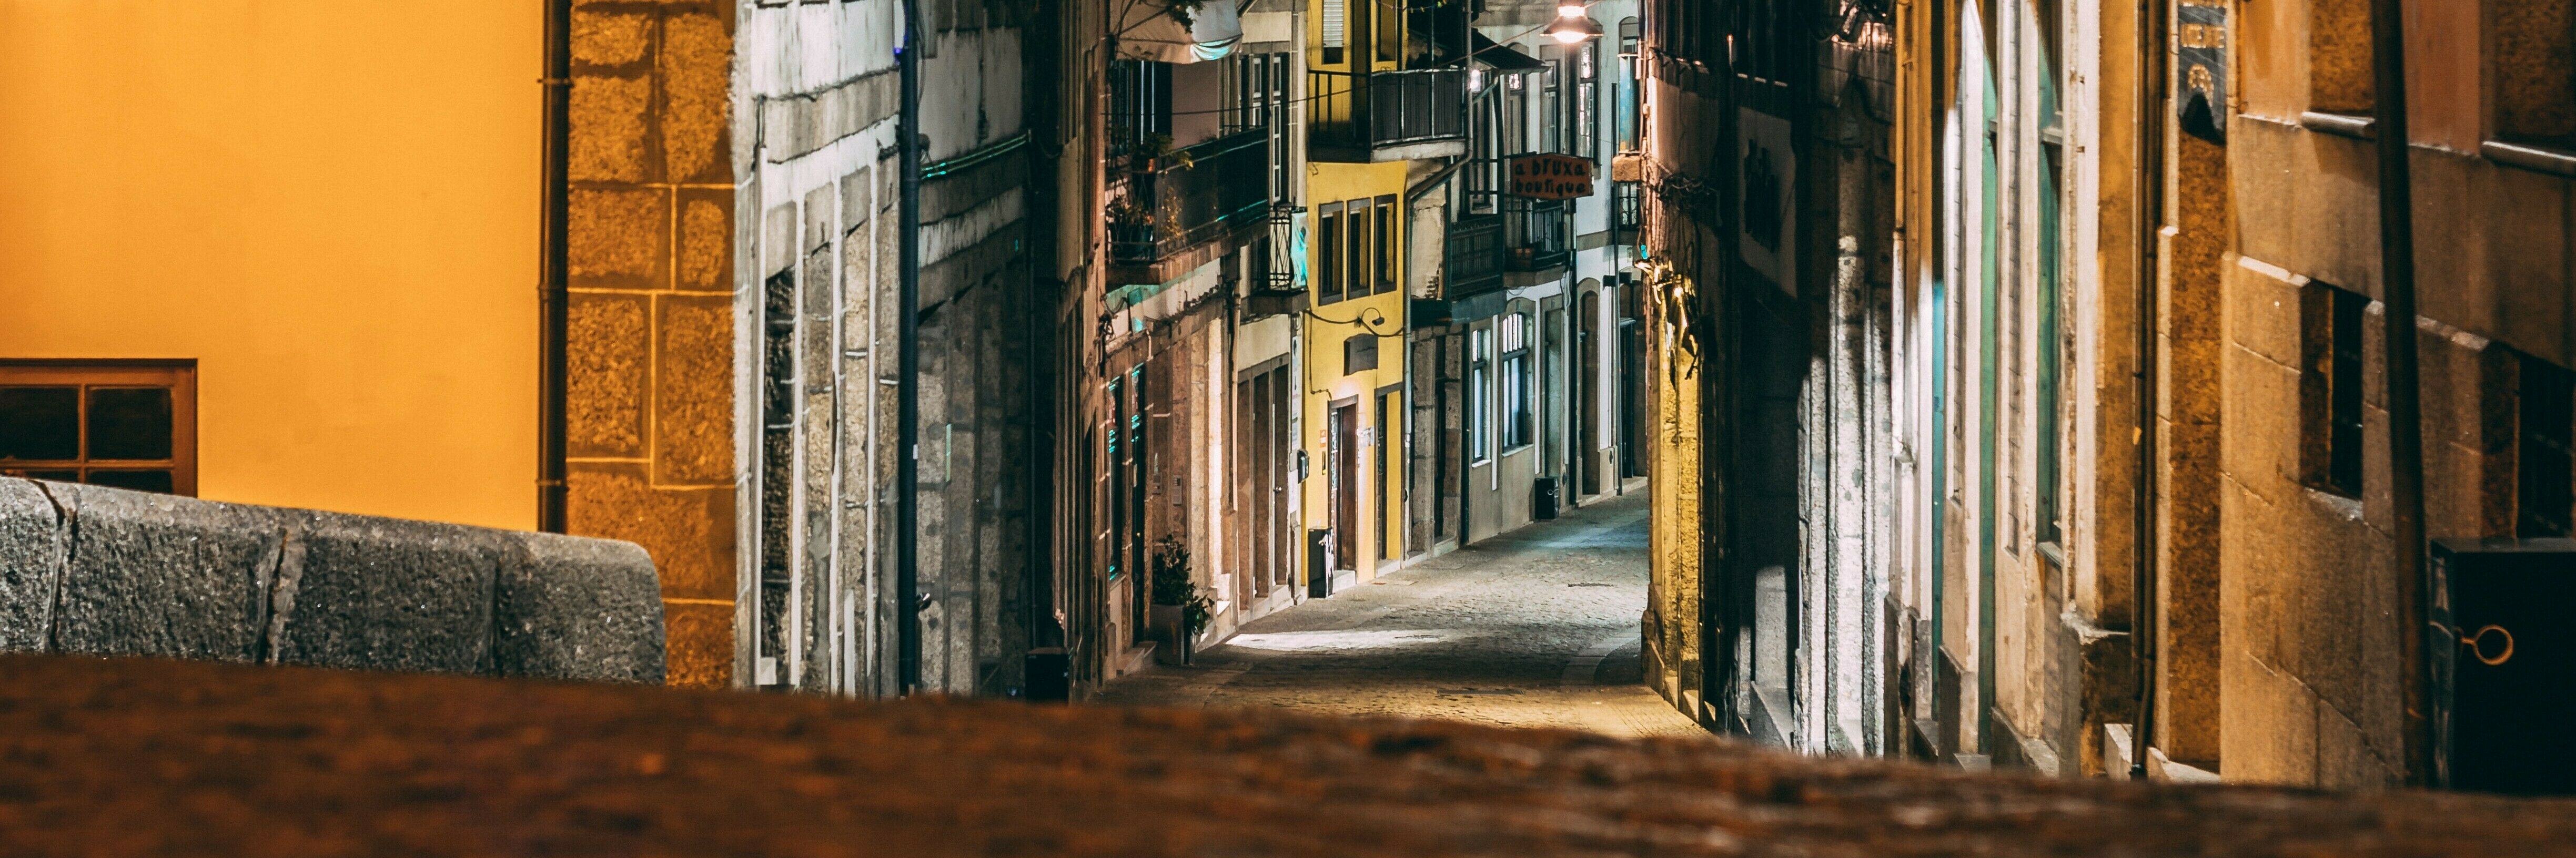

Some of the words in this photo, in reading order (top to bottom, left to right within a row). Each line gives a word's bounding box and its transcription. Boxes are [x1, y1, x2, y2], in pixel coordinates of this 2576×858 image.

[1515, 163, 1525, 175] a
[1532, 159, 1585, 176] bruxa
[1516, 179, 1585, 196] boutique
